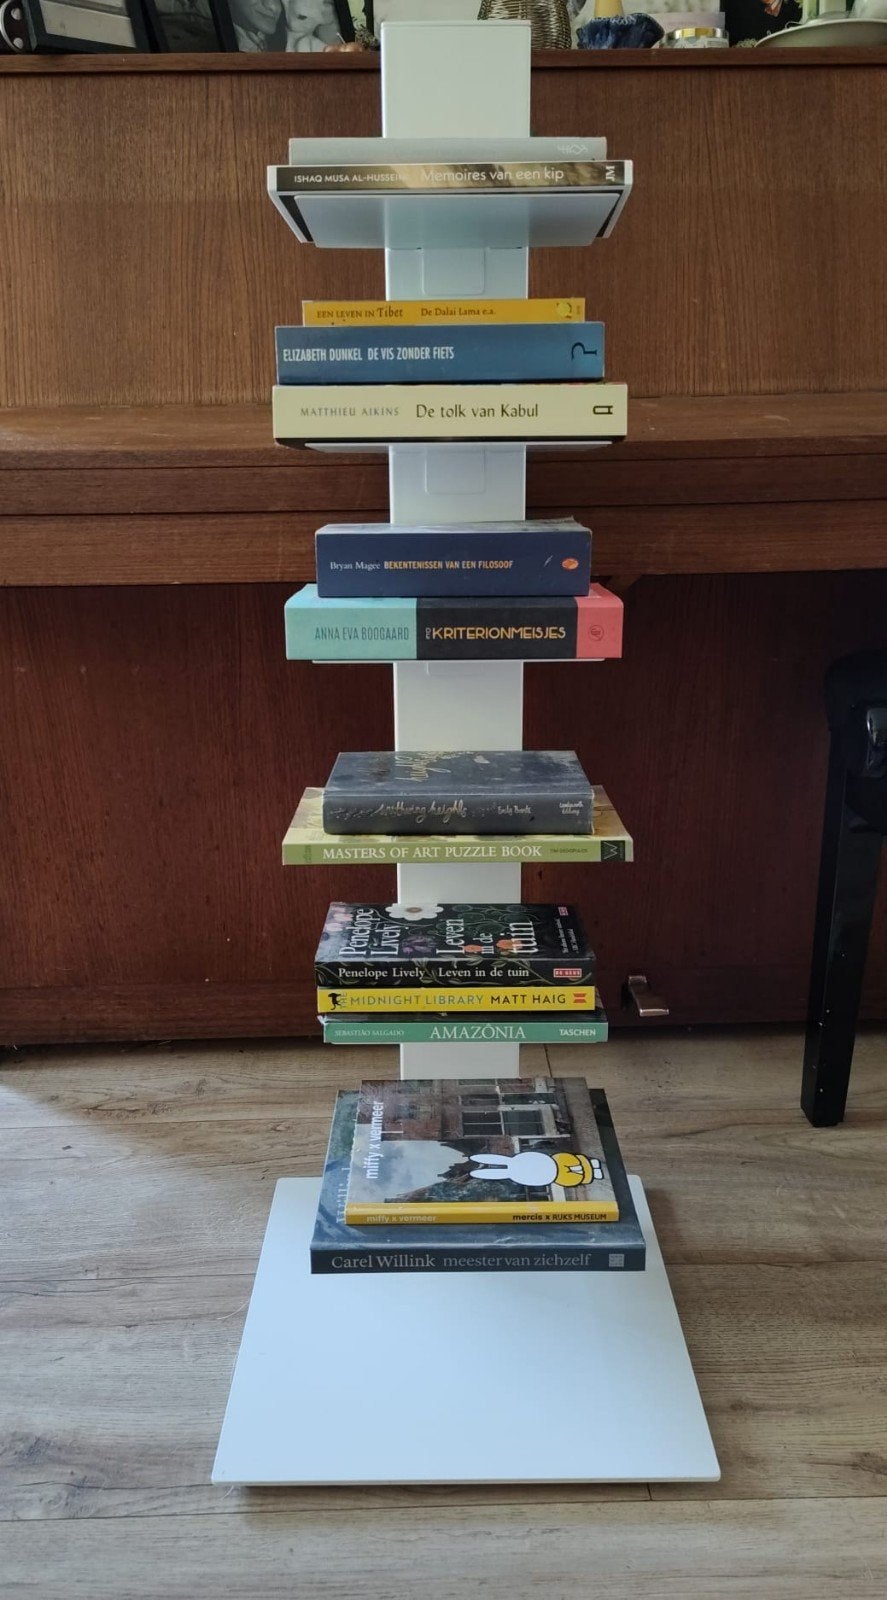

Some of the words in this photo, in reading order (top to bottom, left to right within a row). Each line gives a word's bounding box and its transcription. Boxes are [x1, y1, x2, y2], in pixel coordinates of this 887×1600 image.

[294, 174, 322, 183] ISHAQ
[324, 174, 350, 183] MUSA
[422, 168, 486, 182] Memoires
[489, 170, 513, 180] van
[515, 168, 541, 179] een
[544, 166, 564, 182] kip
[316, 310, 334, 319] EEN
[336, 310, 363, 318] LEVEN
[364, 310, 375, 318] IN
[377, 306, 403, 318] Tibet
[420, 307, 432, 316] De
[434, 307, 456, 316] Dalai
[458, 307, 480, 316] Lama
[282, 348, 327, 362] ELIZABETH
[329, 347, 362, 361] DUNKEL
[367, 347, 379, 361] DE
[381, 347, 394, 360] VIS
[396, 346, 431, 360] ZONDER
[433, 346, 454, 360] FIETS
[300, 407, 356, 417] MATTHIEU
[361, 406, 400, 416] AIKINS
[416, 403, 435, 418] De
[440, 404, 466, 418] tolk
[471, 407, 495, 418] van
[500, 403, 539, 418] Kabul
[329, 561, 353, 571] Bryan
[355, 561, 381, 571] Magee
[383, 560, 443, 570] BEKENTENISSEN
[445, 560, 460, 570] VAN
[461, 560, 476, 569] EEN
[478, 560, 514, 569] FILOSOOF
[315, 627, 340, 640] ANNA
[342, 627, 359, 640] EVA
[361, 627, 410, 640] BOOGAARD
[432, 626, 566, 640] KRITERIONMEISJES
[323, 848, 386, 859] MASTERS
[389, 847, 409, 859] OF
[412, 847, 441, 858] ART
[445, 847, 497, 858] PUZZLE
[501, 846, 542, 857] BOOK
[339, 908, 380, 955] Penelope
[436, 918, 465, 954] Leven
[500, 920, 539, 954] tuin
[371, 923, 401, 955] Lively
[338, 967, 388, 980] Penelope
[392, 967, 426, 980] Lively
[438, 968, 471, 978] Leven
[475, 967, 486, 977] in
[489, 967, 504, 977] de
[507, 967, 530, 977] tuin
[350, 995, 422, 1006] MIDNIGHT
[425, 995, 484, 1005] LIBRARY
[490, 994, 528, 1005] MATT
[532, 993, 566, 1004] HAIG
[429, 1023, 526, 1039] AMAZÔNIA
[558, 1028, 596, 1037] TASCHEN
[370, 1100, 384, 1142] vermeer
[371, 1143, 381, 1151] x
[363, 1153, 384, 1179] miffy
[366, 1214, 390, 1223] miffy
[512, 1213, 543, 1221] mercis
[331, 1256, 373, 1269] Carel
[377, 1254, 436, 1268] Willink
[443, 1255, 503, 1267] meester
[504, 1256, 531, 1266] van
[533, 1253, 592, 1266] zichzelf
